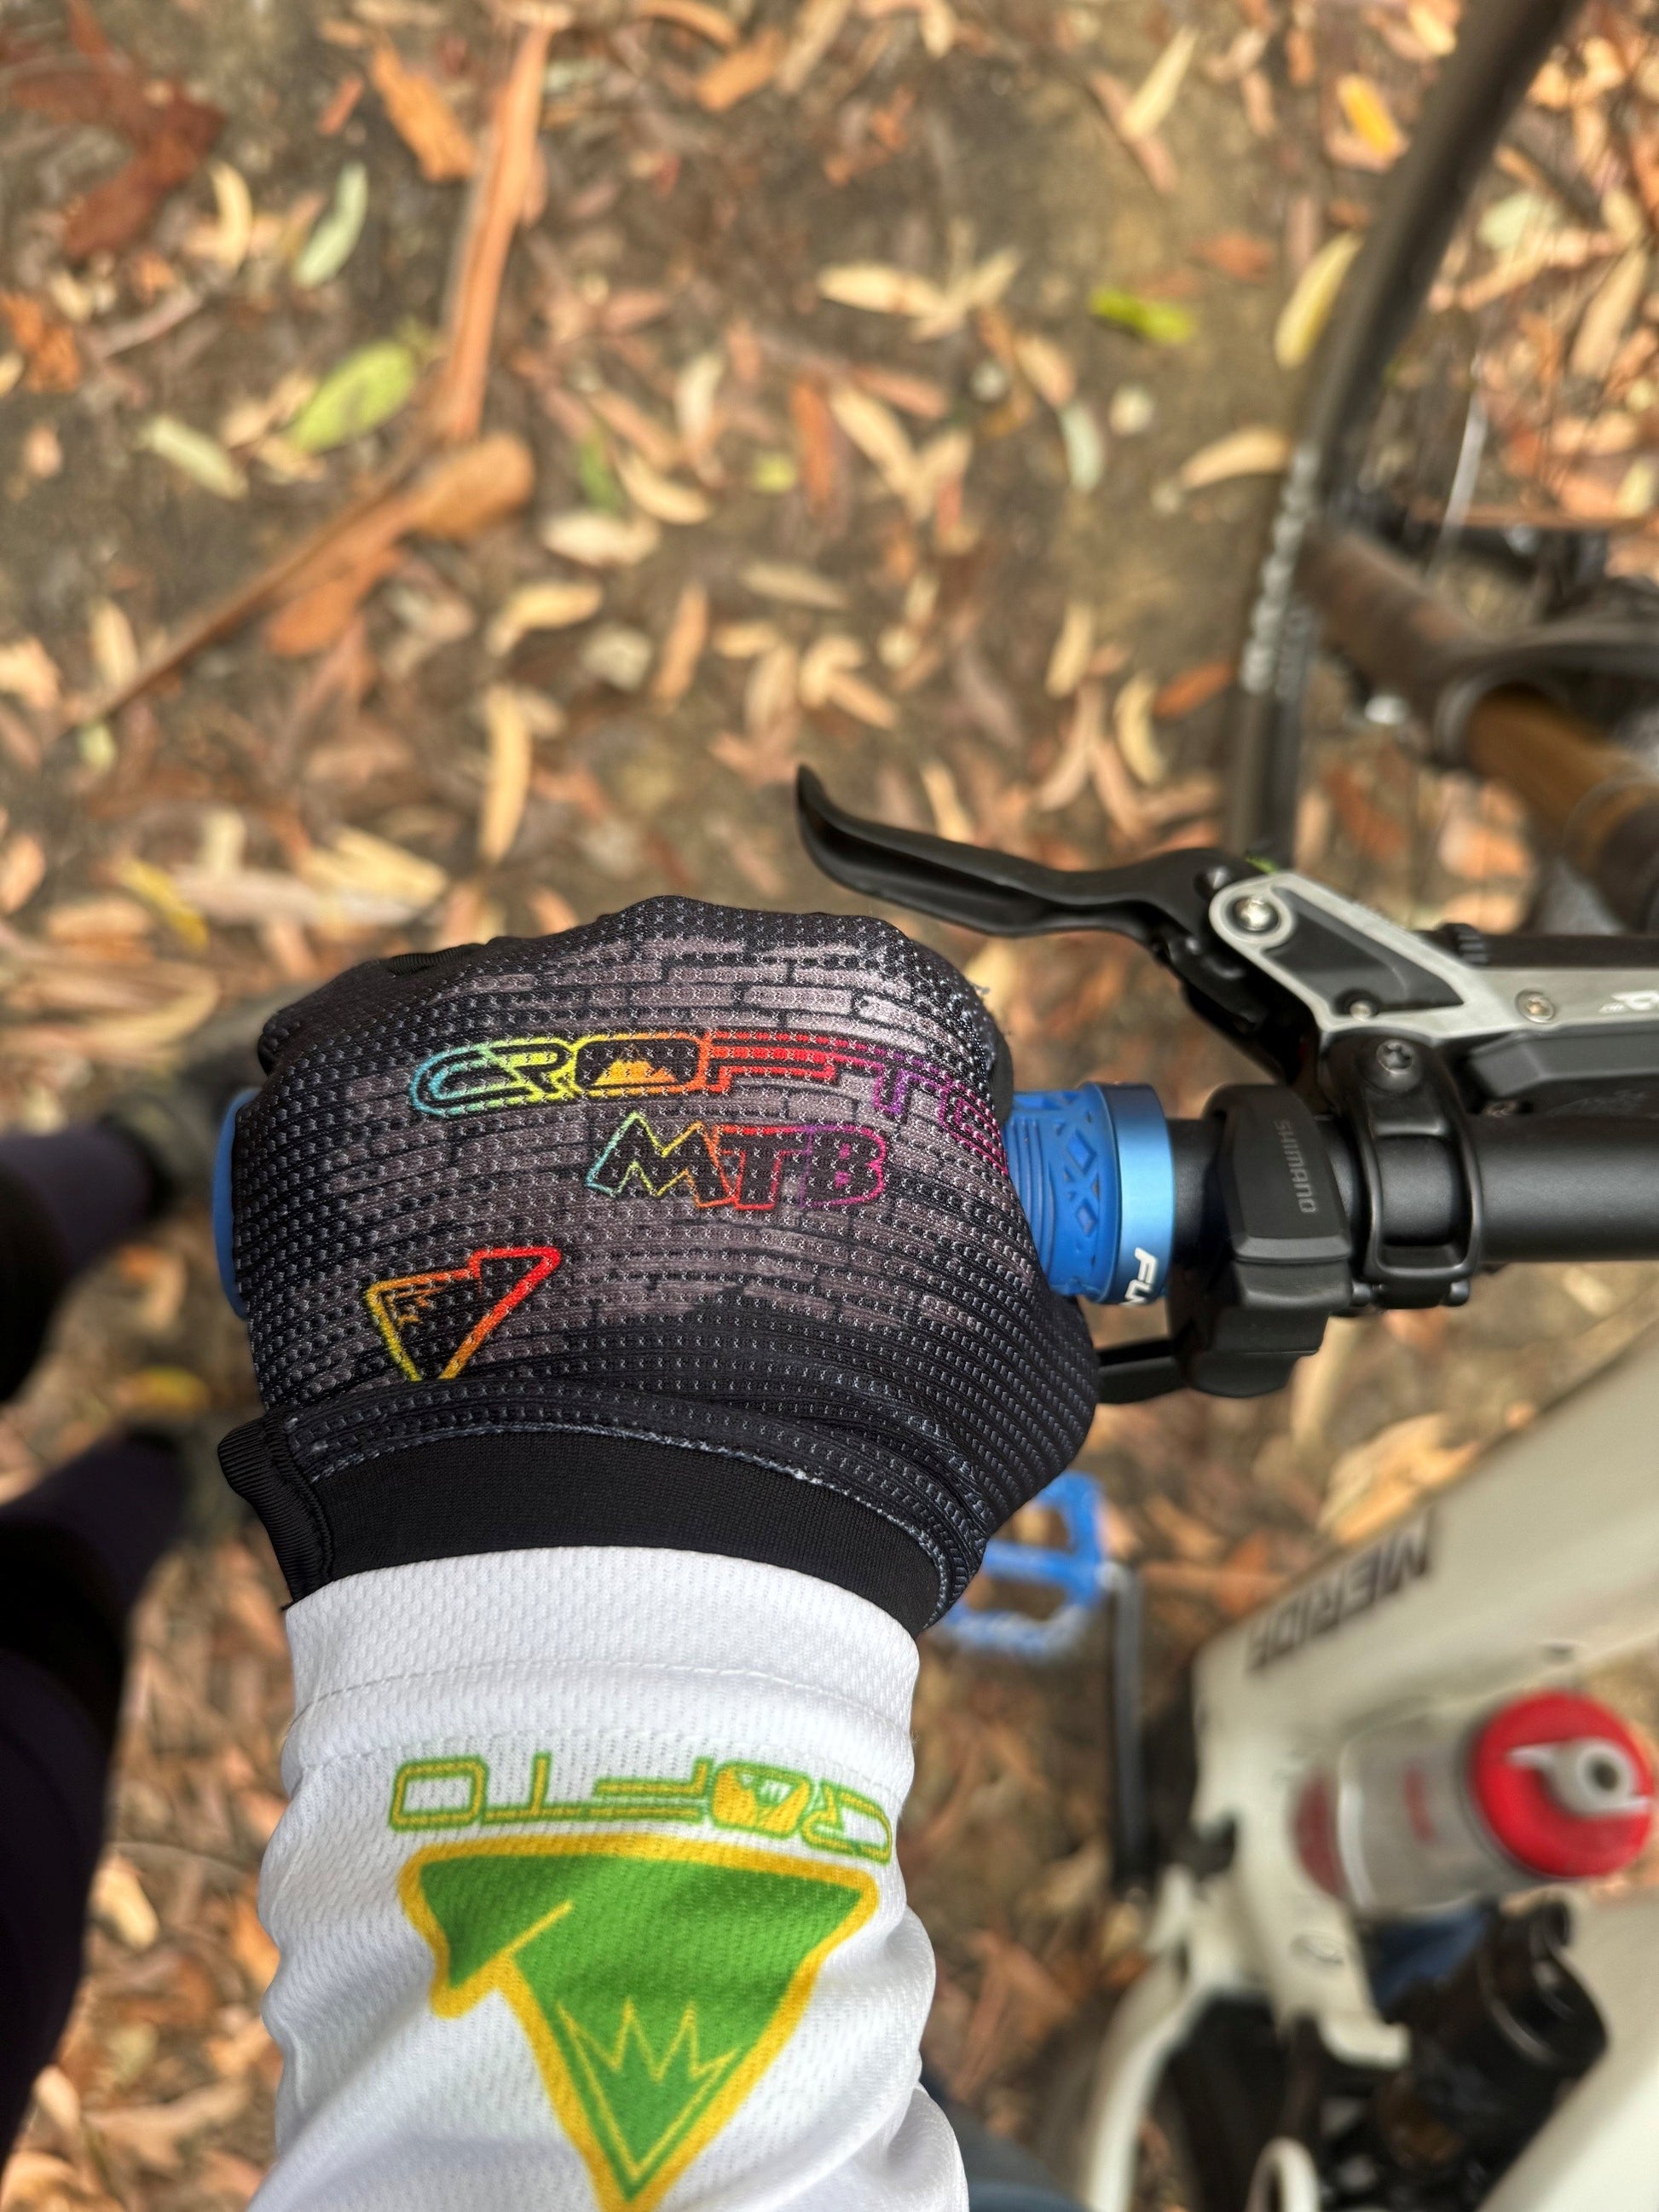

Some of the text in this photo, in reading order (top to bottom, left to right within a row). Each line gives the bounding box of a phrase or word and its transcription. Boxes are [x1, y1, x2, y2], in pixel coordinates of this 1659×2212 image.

[586, 1112, 887, 1211] MTB
[1275, 1119, 1317, 1215] SHIMANO
[1120, 1247, 1158, 1307] FU
[389, 1752, 893, 1865] CROFTO
